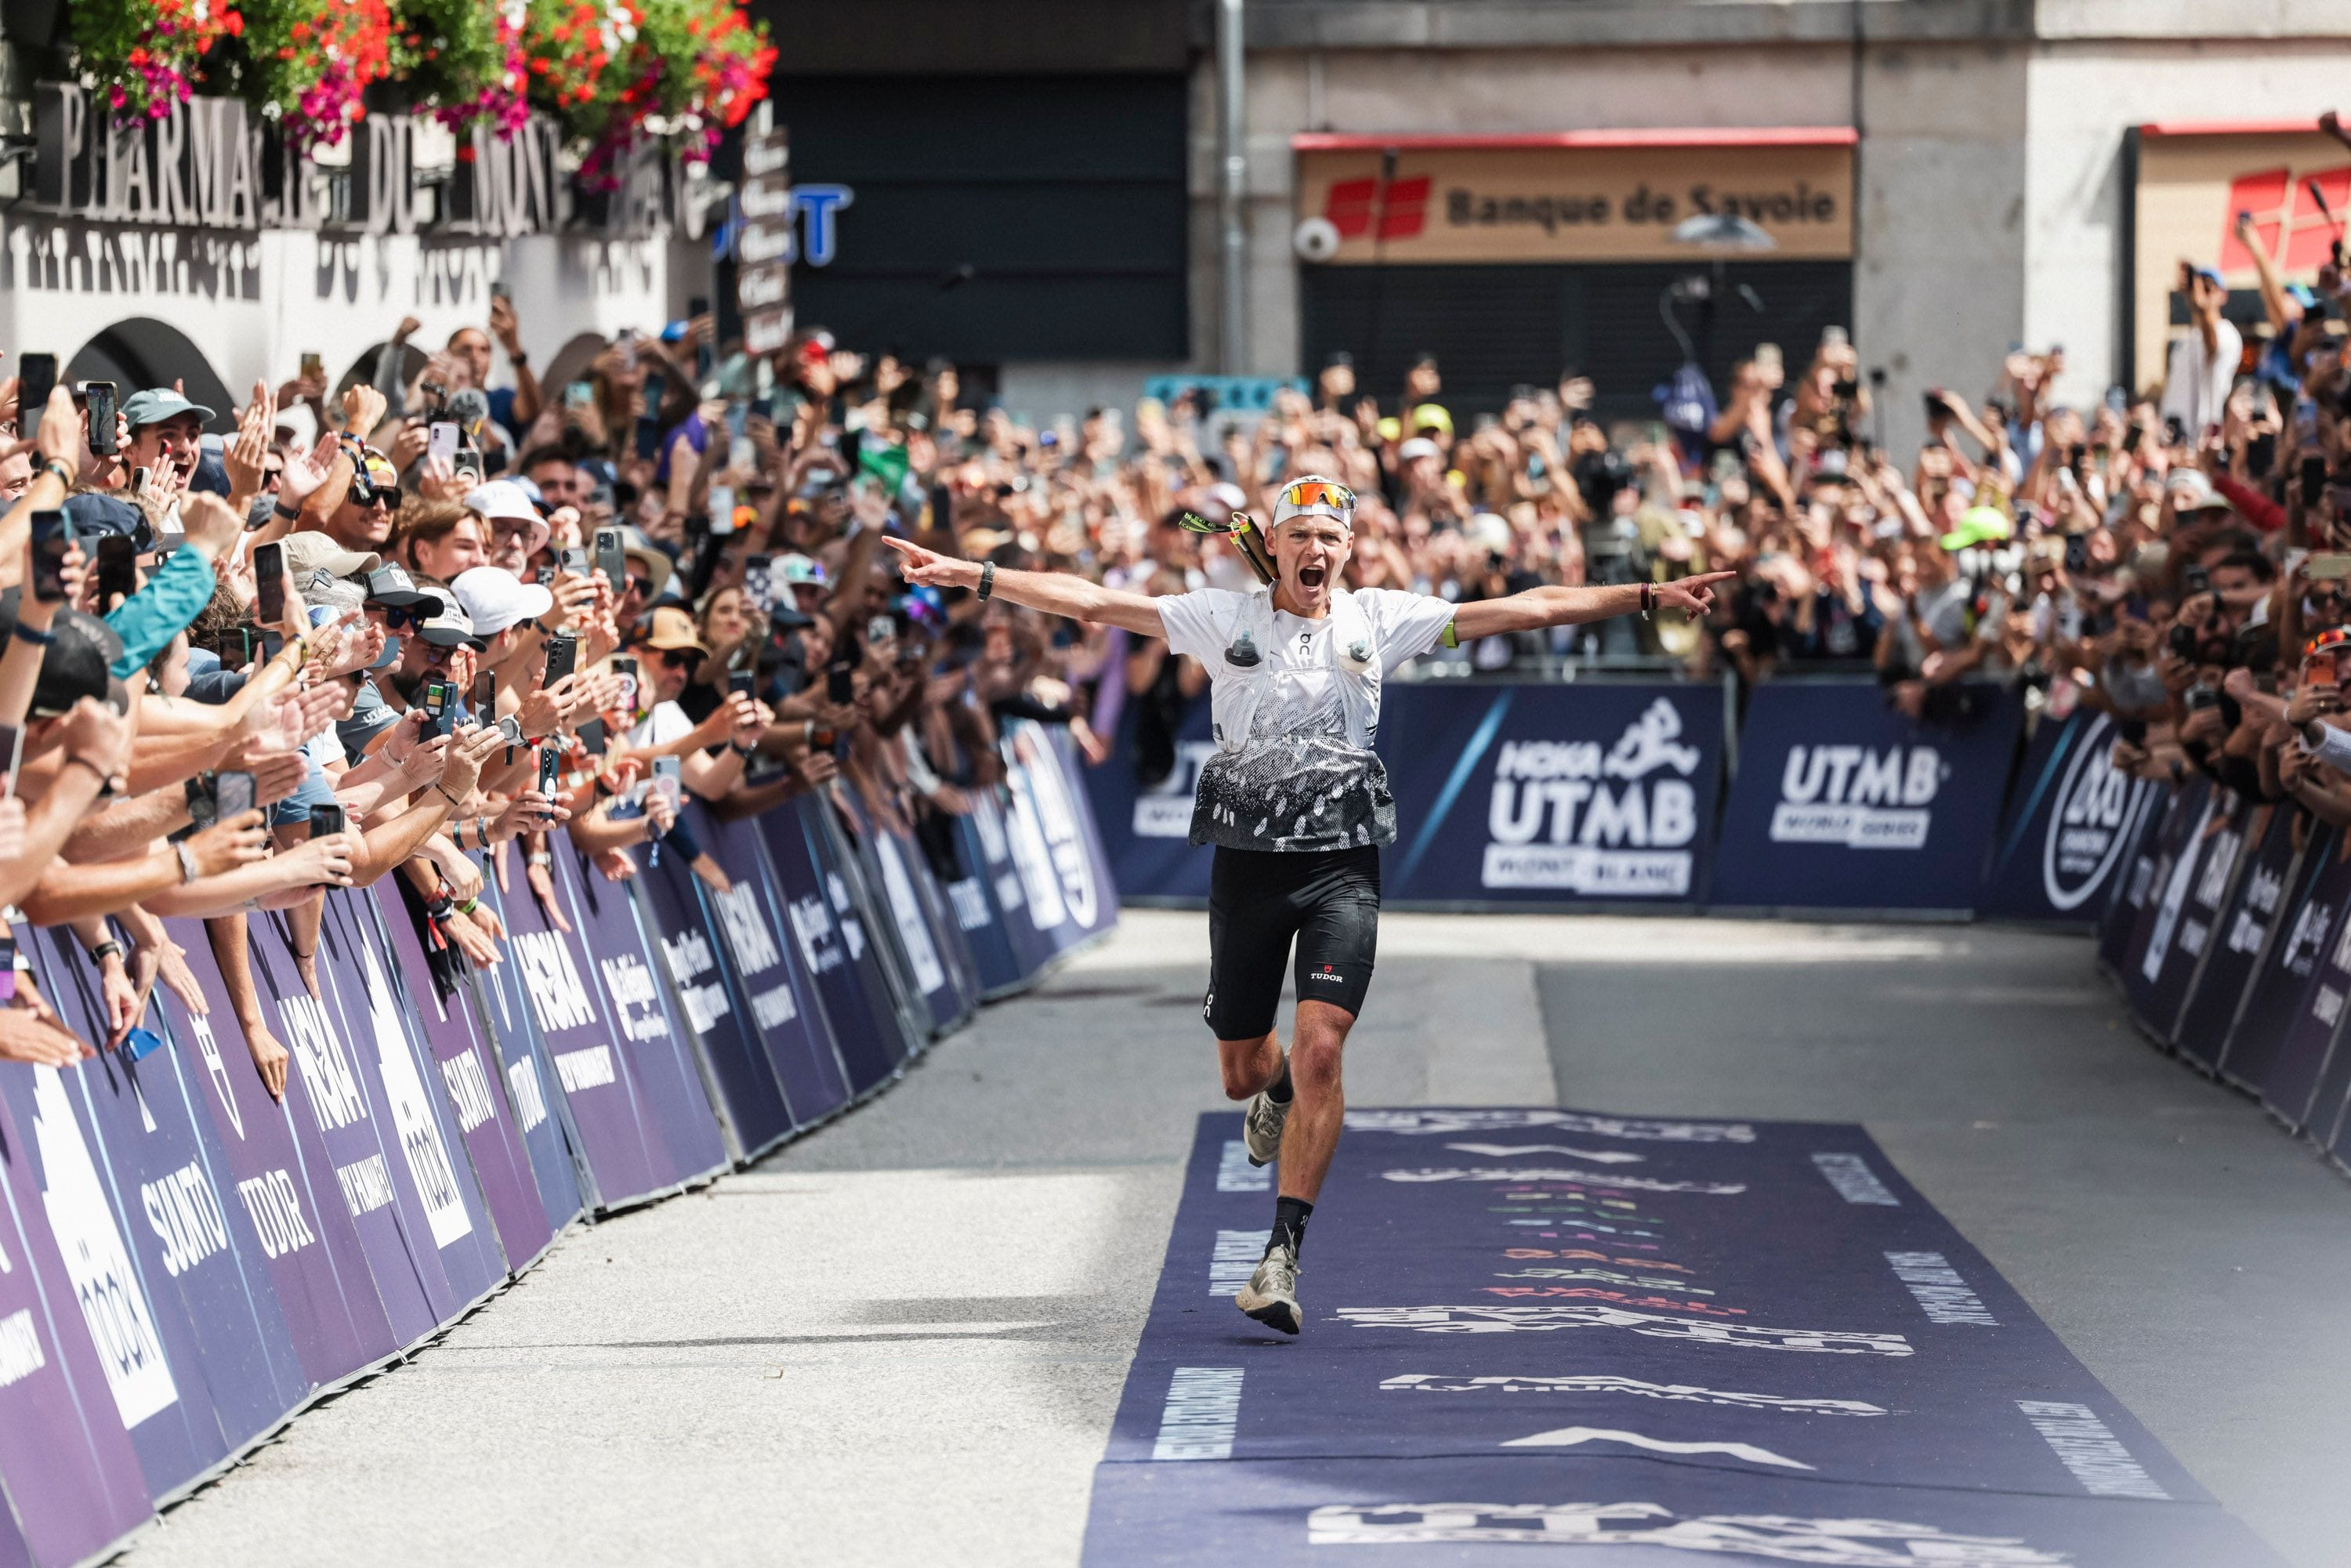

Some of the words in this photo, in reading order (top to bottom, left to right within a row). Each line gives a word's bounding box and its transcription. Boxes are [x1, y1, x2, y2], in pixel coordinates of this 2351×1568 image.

[1447, 188, 1607, 236] Banque
[1624, 183, 1675, 221] de
[1691, 180, 1836, 224] Savoie
[1498, 741, 1601, 780] HOKA
[1781, 744, 1940, 806] UTMB
[1491, 782, 1698, 847] UTMB
[1311, 972, 1343, 983] TUDOR
[276, 994, 367, 1132] HOKA
[442, 1048, 494, 1135] SUUNTO
[141, 1161, 227, 1277] SUUNTO
[1379, 1384, 1487, 1394] FLY
[1502, 1385, 1765, 1408] HUMAN
